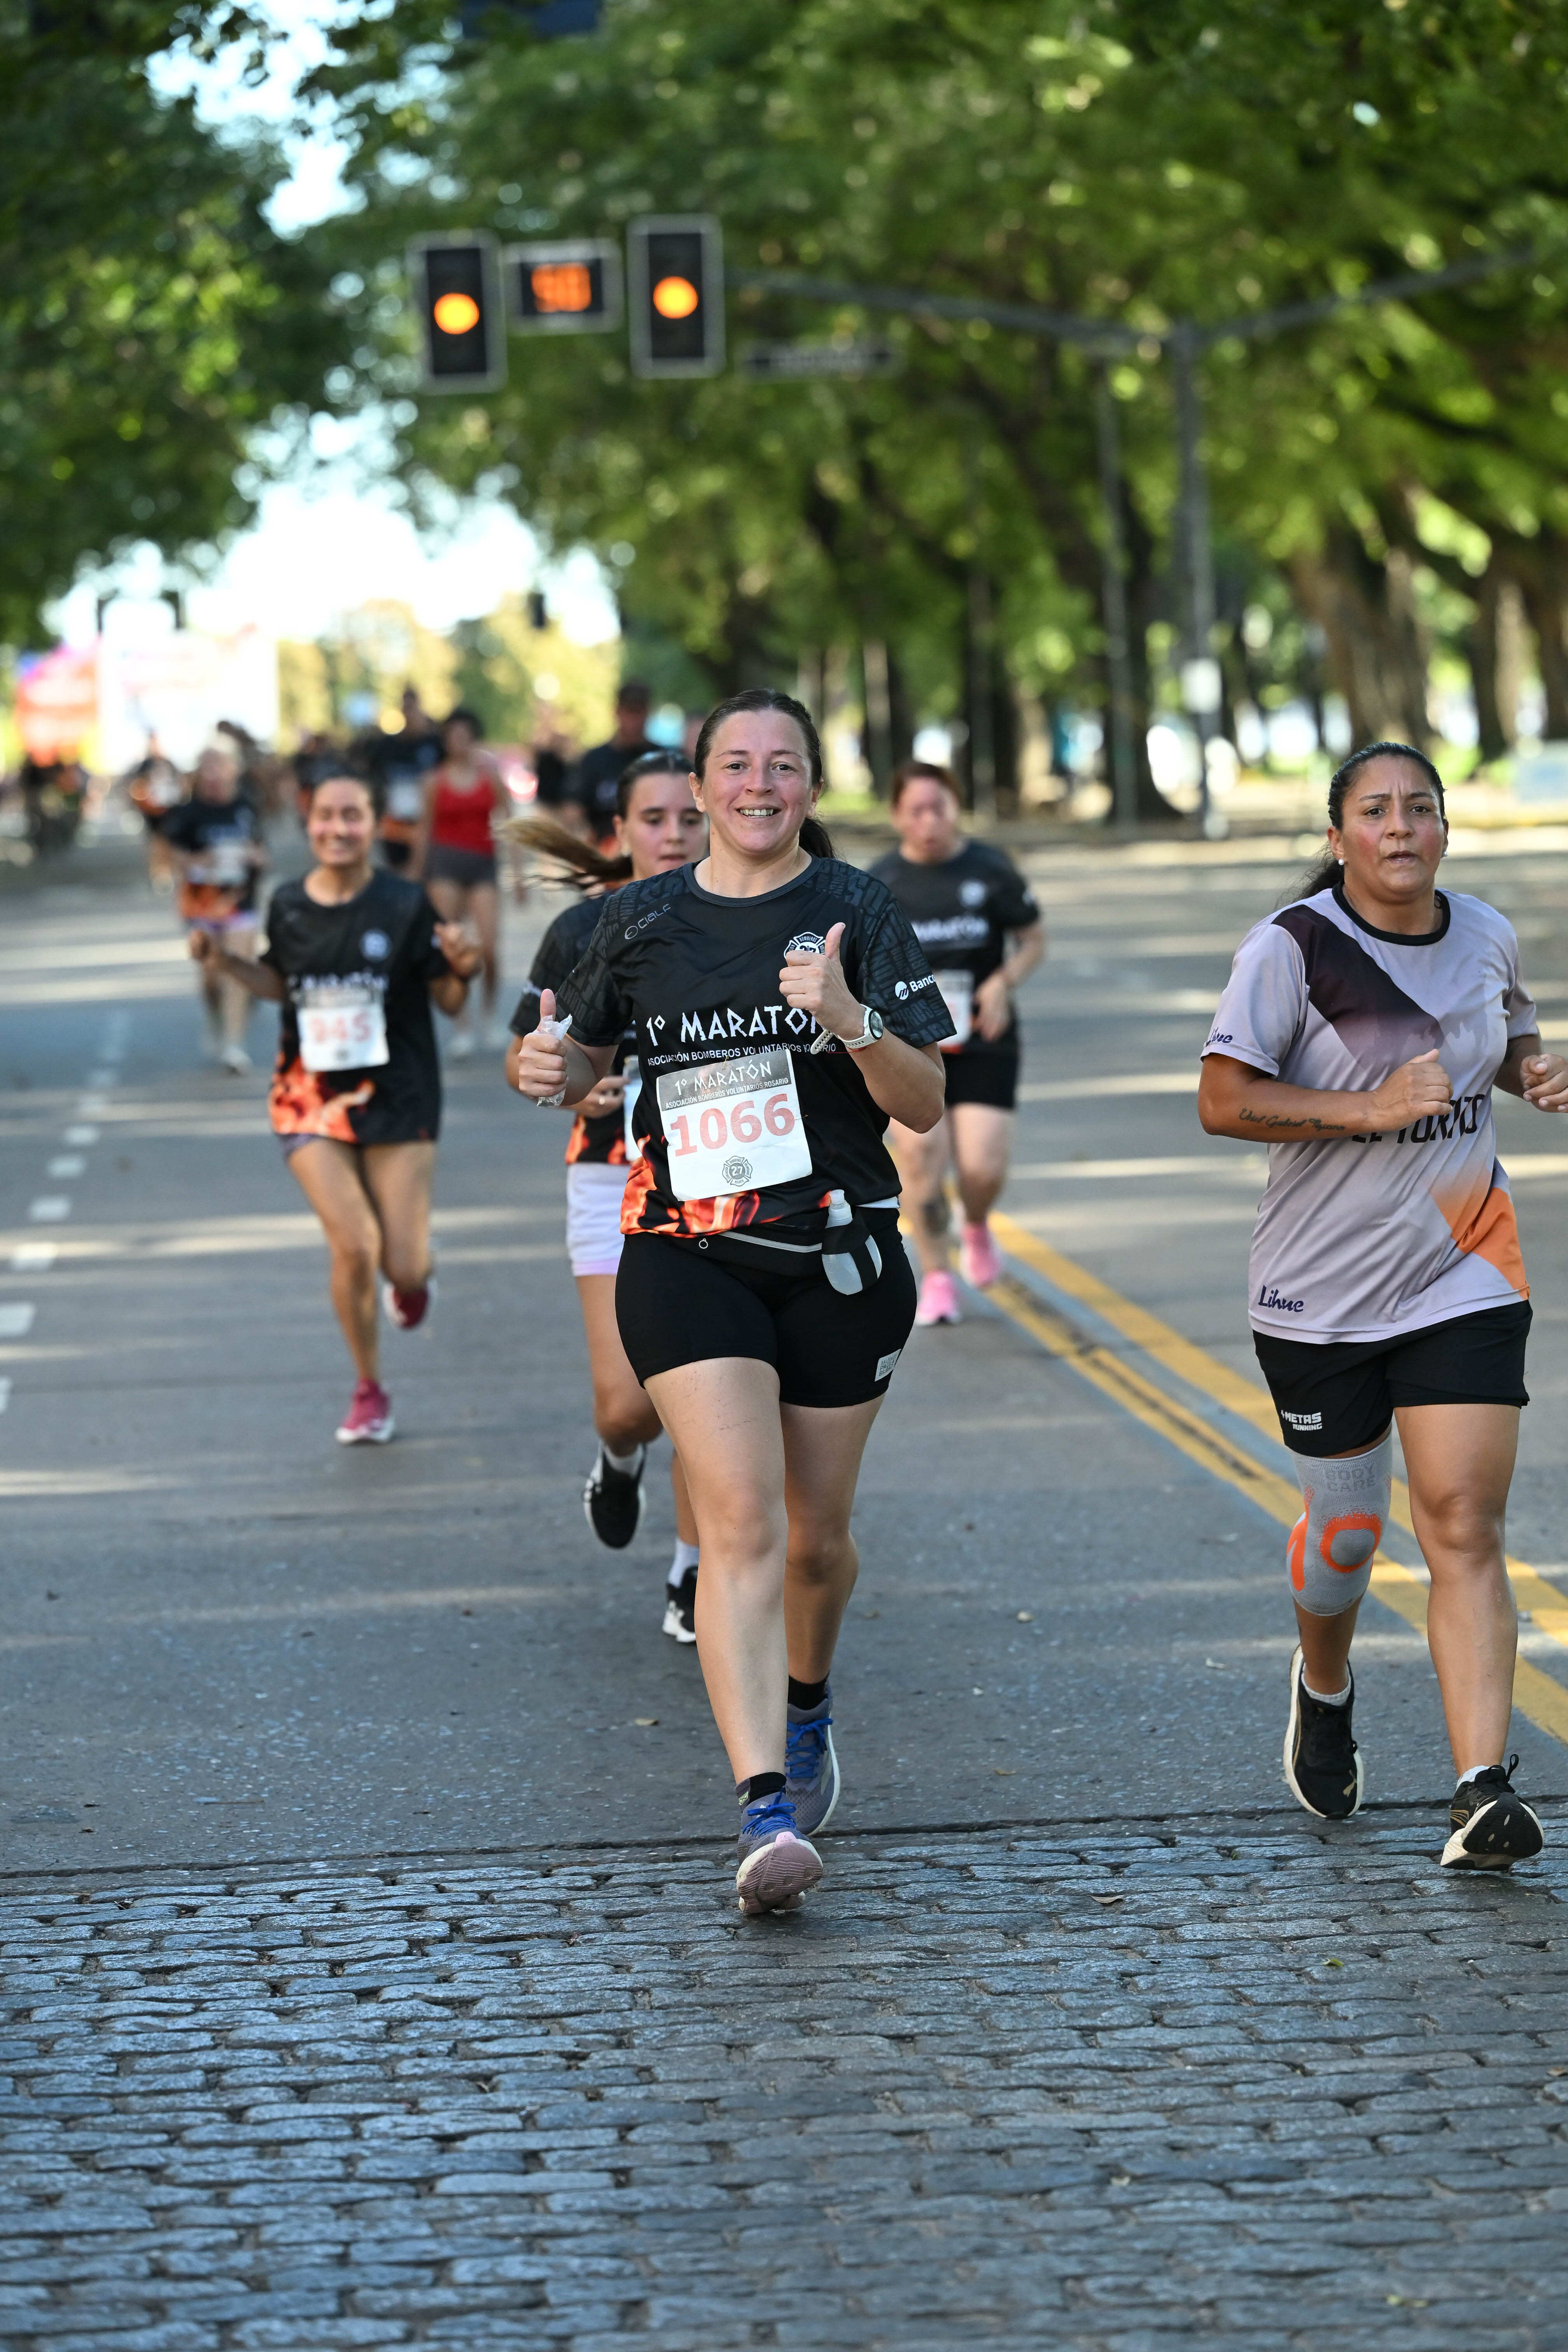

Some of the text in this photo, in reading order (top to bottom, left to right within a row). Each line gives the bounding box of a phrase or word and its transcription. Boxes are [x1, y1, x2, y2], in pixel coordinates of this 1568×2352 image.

[648, 1052, 690, 1066] ASOCIACIÓN
[691, 1048, 741, 1060] BOMBEROS
[694, 1059, 772, 1092] MARATÓN
[665, 1078, 789, 1109] ASOCIACIÓN BOMBEROS VOLUNTARIOS ROSARIO
[670, 1093, 795, 1157] 1066
[731, 1166, 743, 1176] 27
[1258, 1284, 1304, 1312] Lihue
